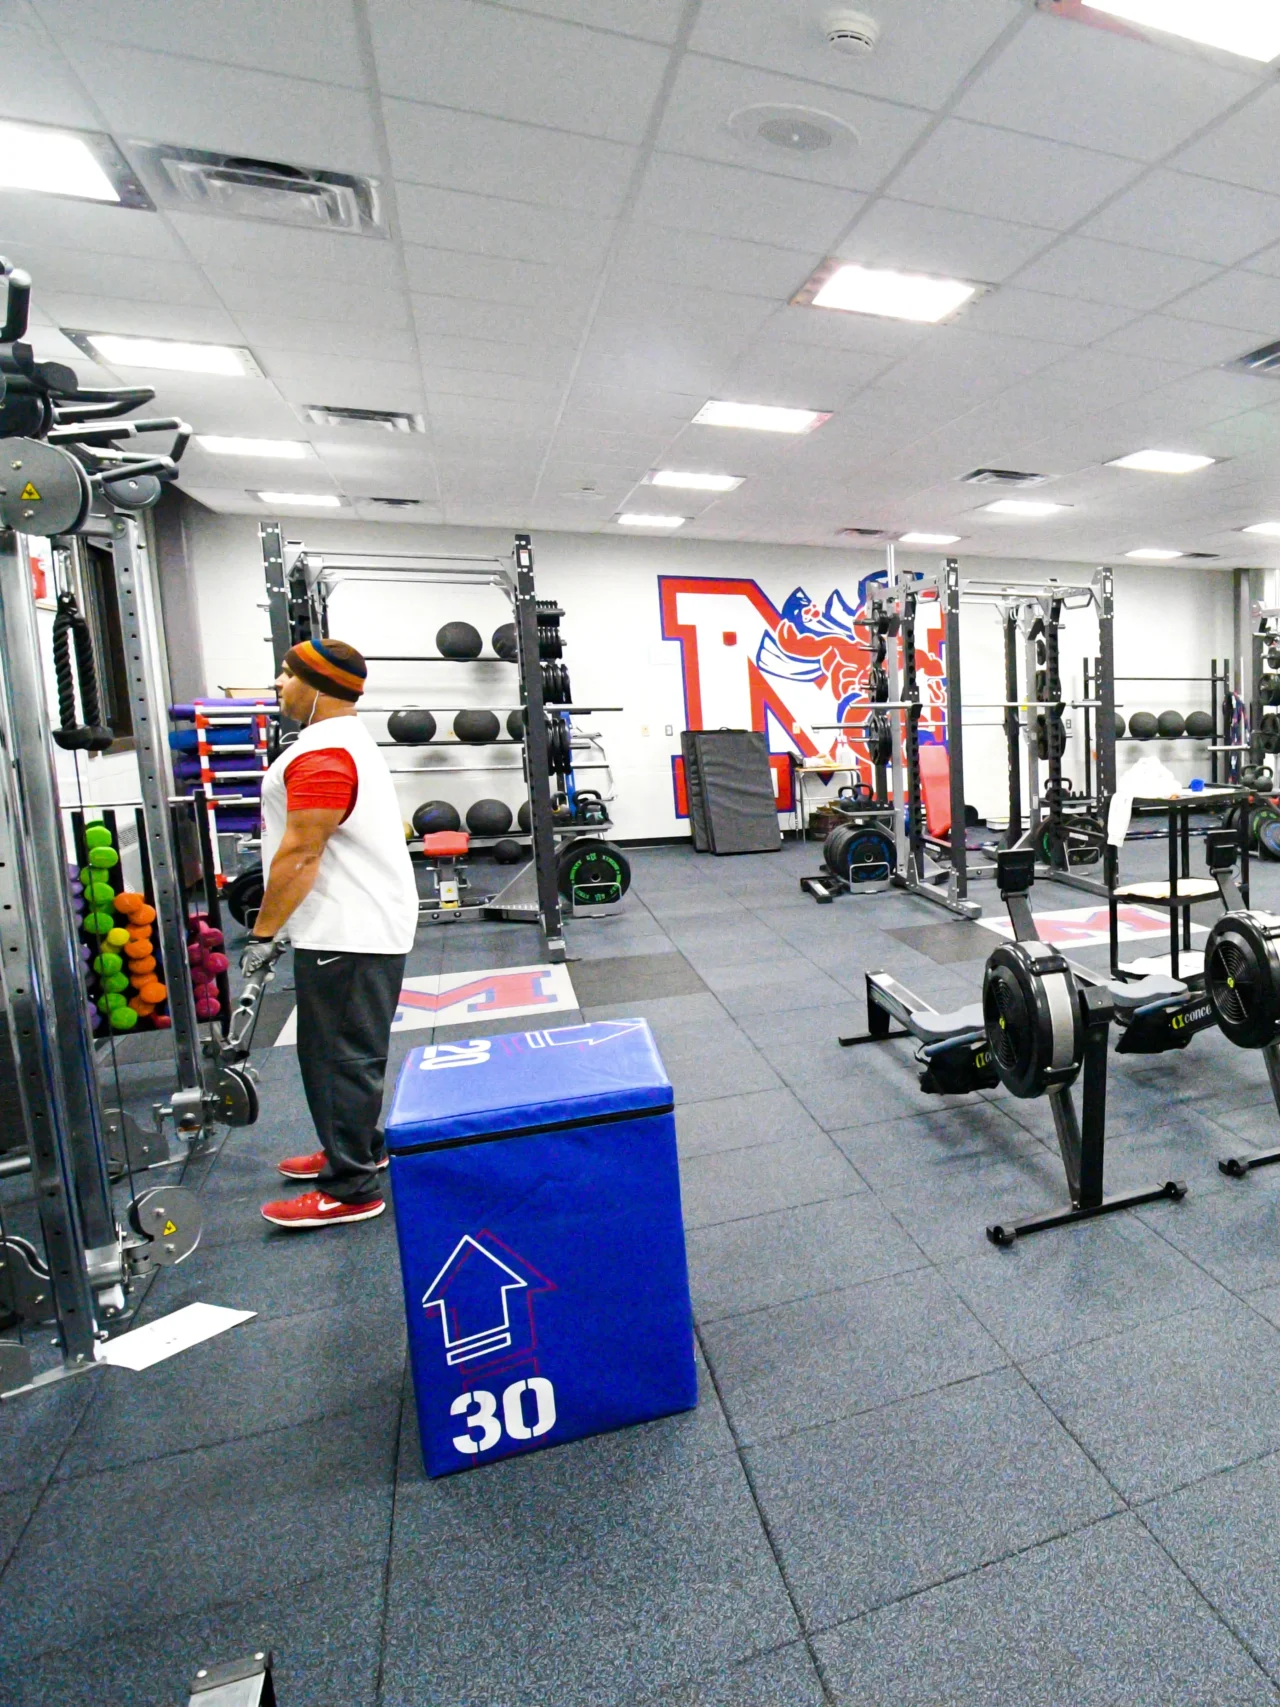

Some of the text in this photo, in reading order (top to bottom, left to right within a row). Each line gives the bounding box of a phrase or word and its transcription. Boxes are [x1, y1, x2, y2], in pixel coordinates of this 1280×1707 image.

[1184, 1003, 1213, 1024] conce
[419, 1039, 491, 1070] 20
[449, 1376, 556, 1454] 30
